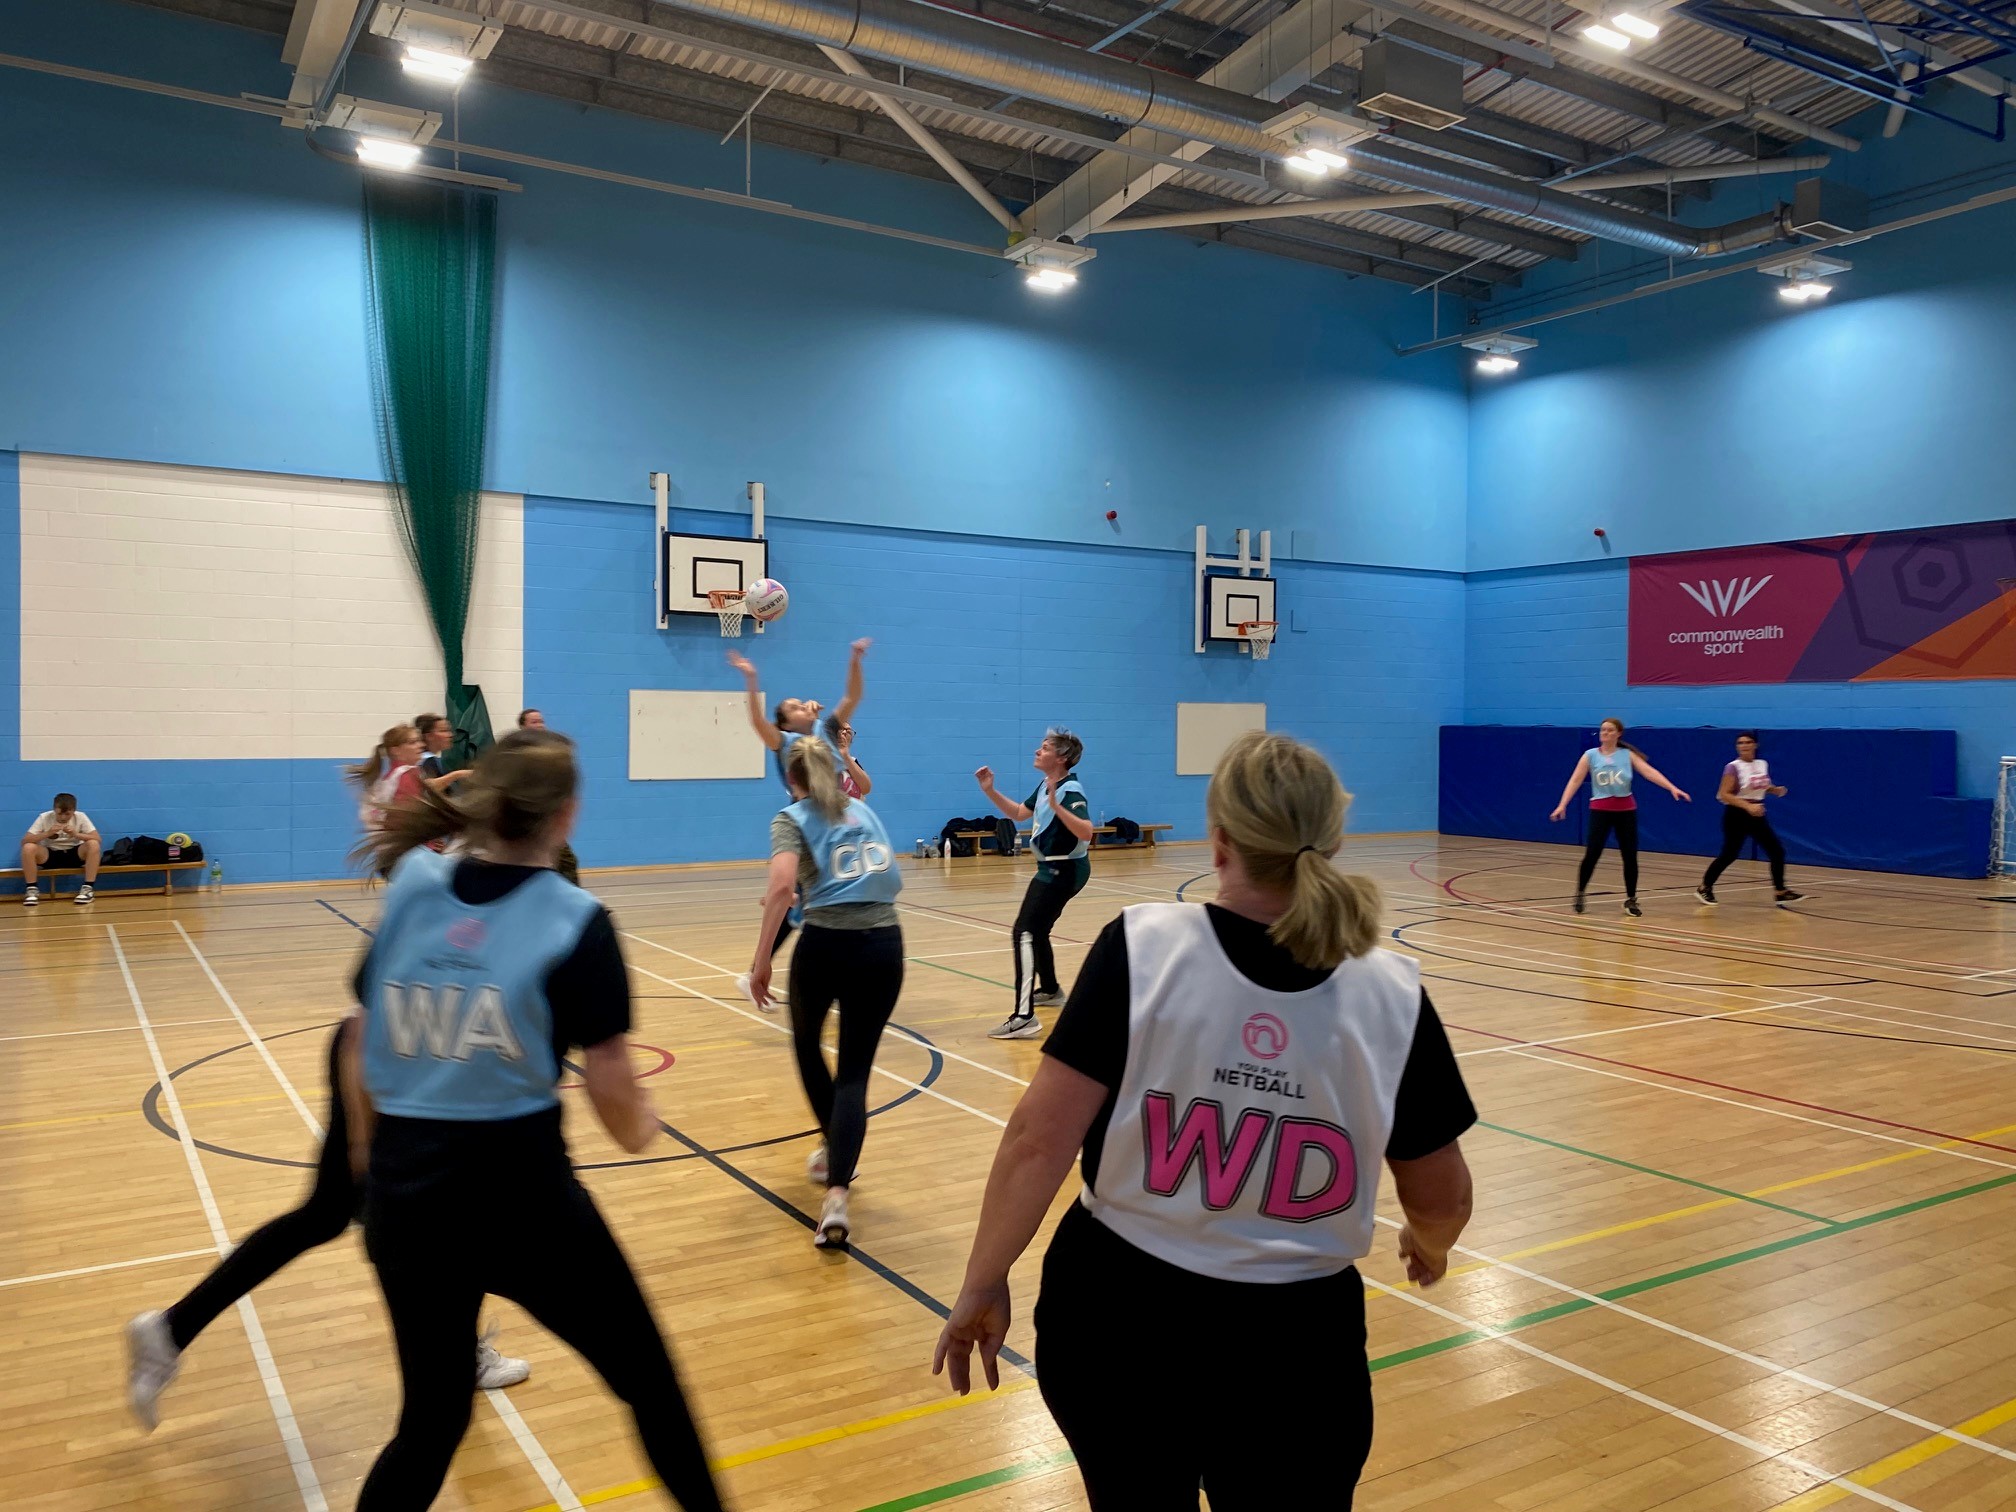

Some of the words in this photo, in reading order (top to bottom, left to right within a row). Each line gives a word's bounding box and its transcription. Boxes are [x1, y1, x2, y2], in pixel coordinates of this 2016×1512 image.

[1668, 625, 1784, 643] commonwealth
[1704, 641, 1744, 656] sport
[1595, 769, 1624, 786] GK
[831, 840, 891, 880] GD
[382, 979, 528, 1062] WA
[1237, 1062, 1259, 1073] YOU
[1261, 1066, 1289, 1078] PLAY
[1213, 1067, 1307, 1099] NETBALL
[1141, 1089, 1358, 1224] WD
